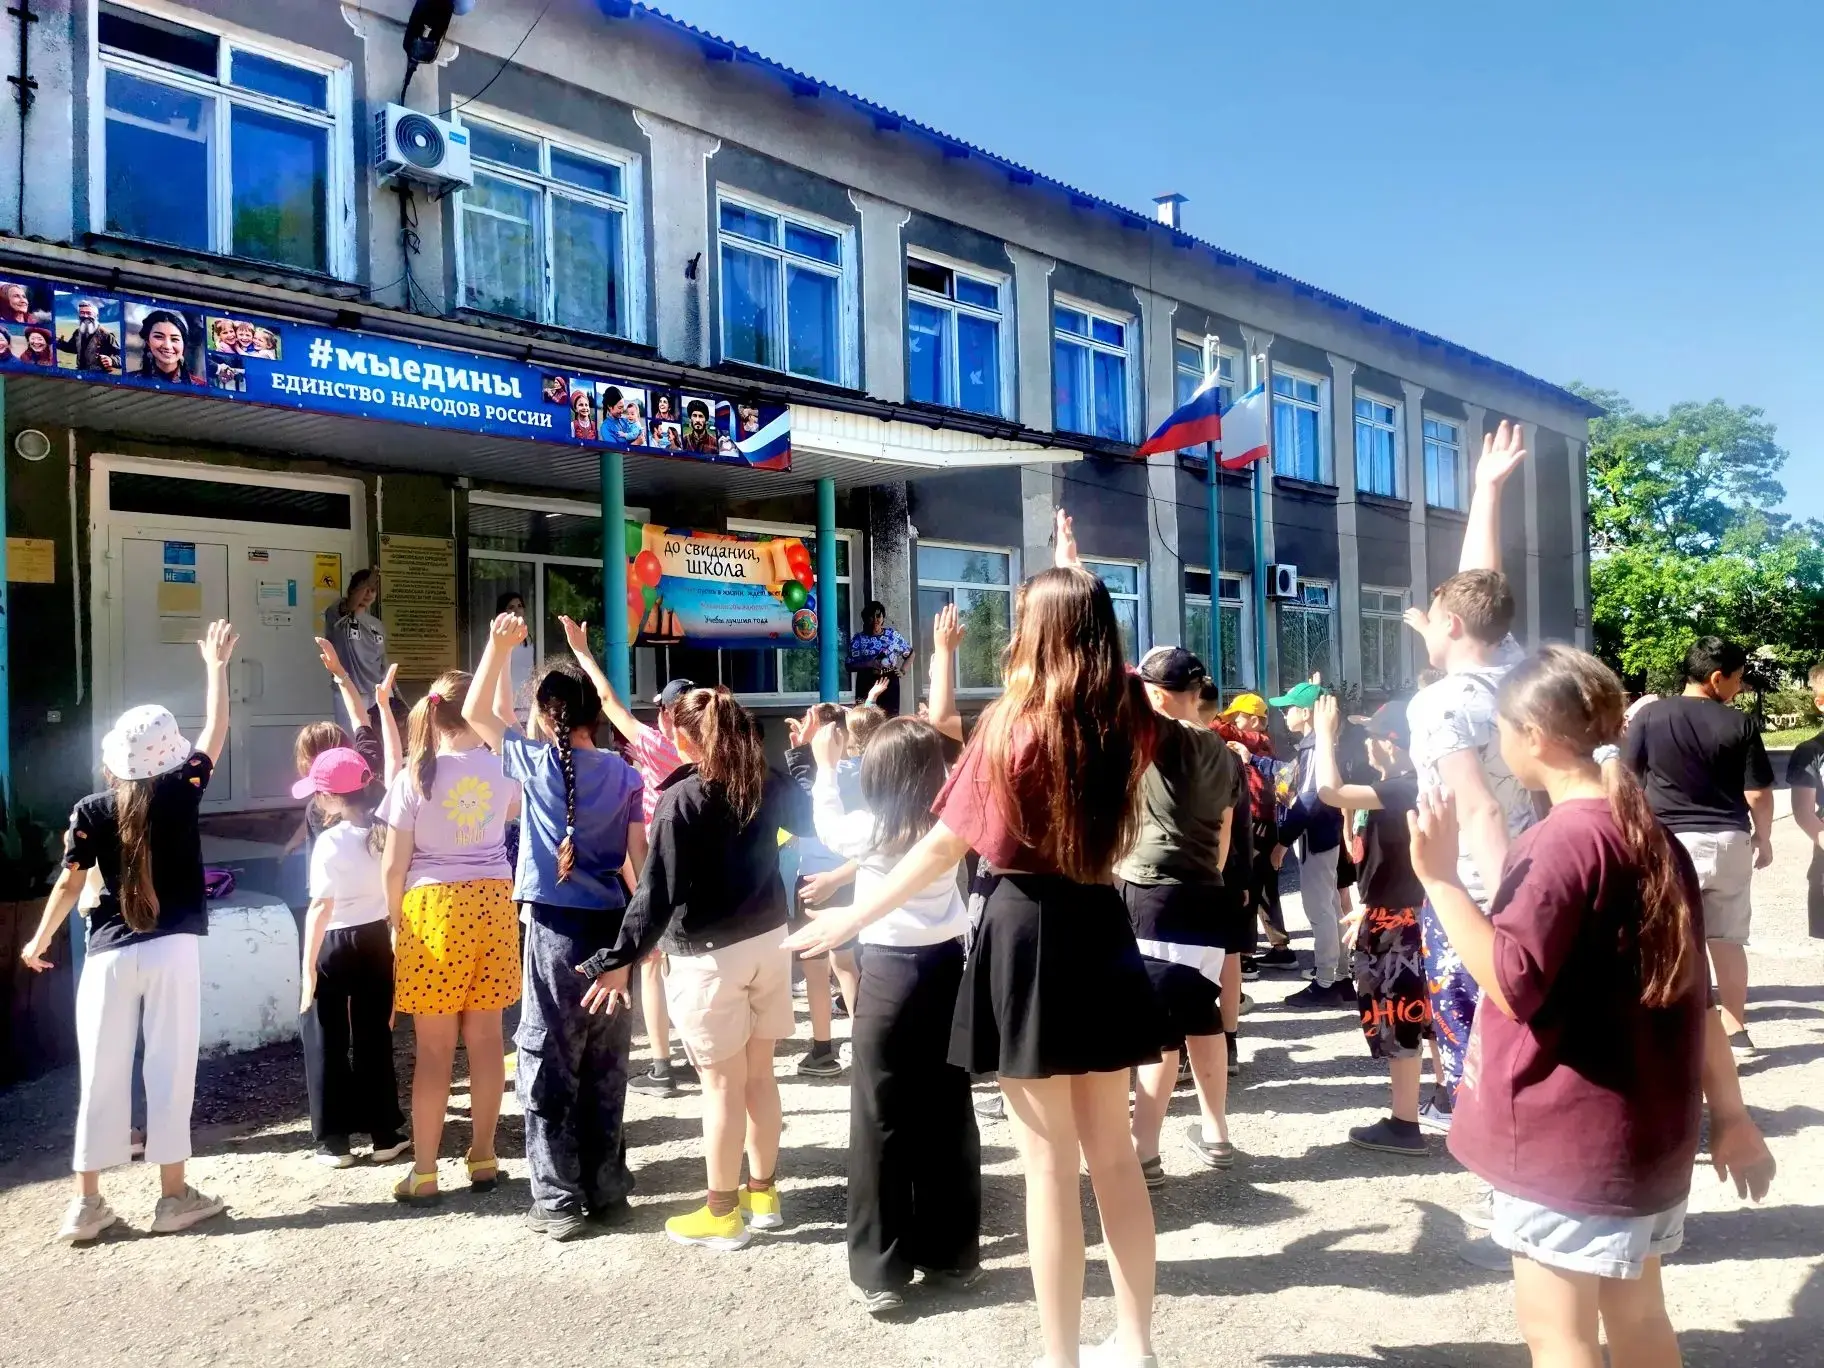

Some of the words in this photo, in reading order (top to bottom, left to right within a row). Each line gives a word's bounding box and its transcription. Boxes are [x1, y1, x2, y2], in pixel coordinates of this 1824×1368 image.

[271, 372, 386, 404] ЕДИНСТВО
[391, 390, 480, 418] НАРОДОВ
[485, 407, 553, 428] РОССИИ
